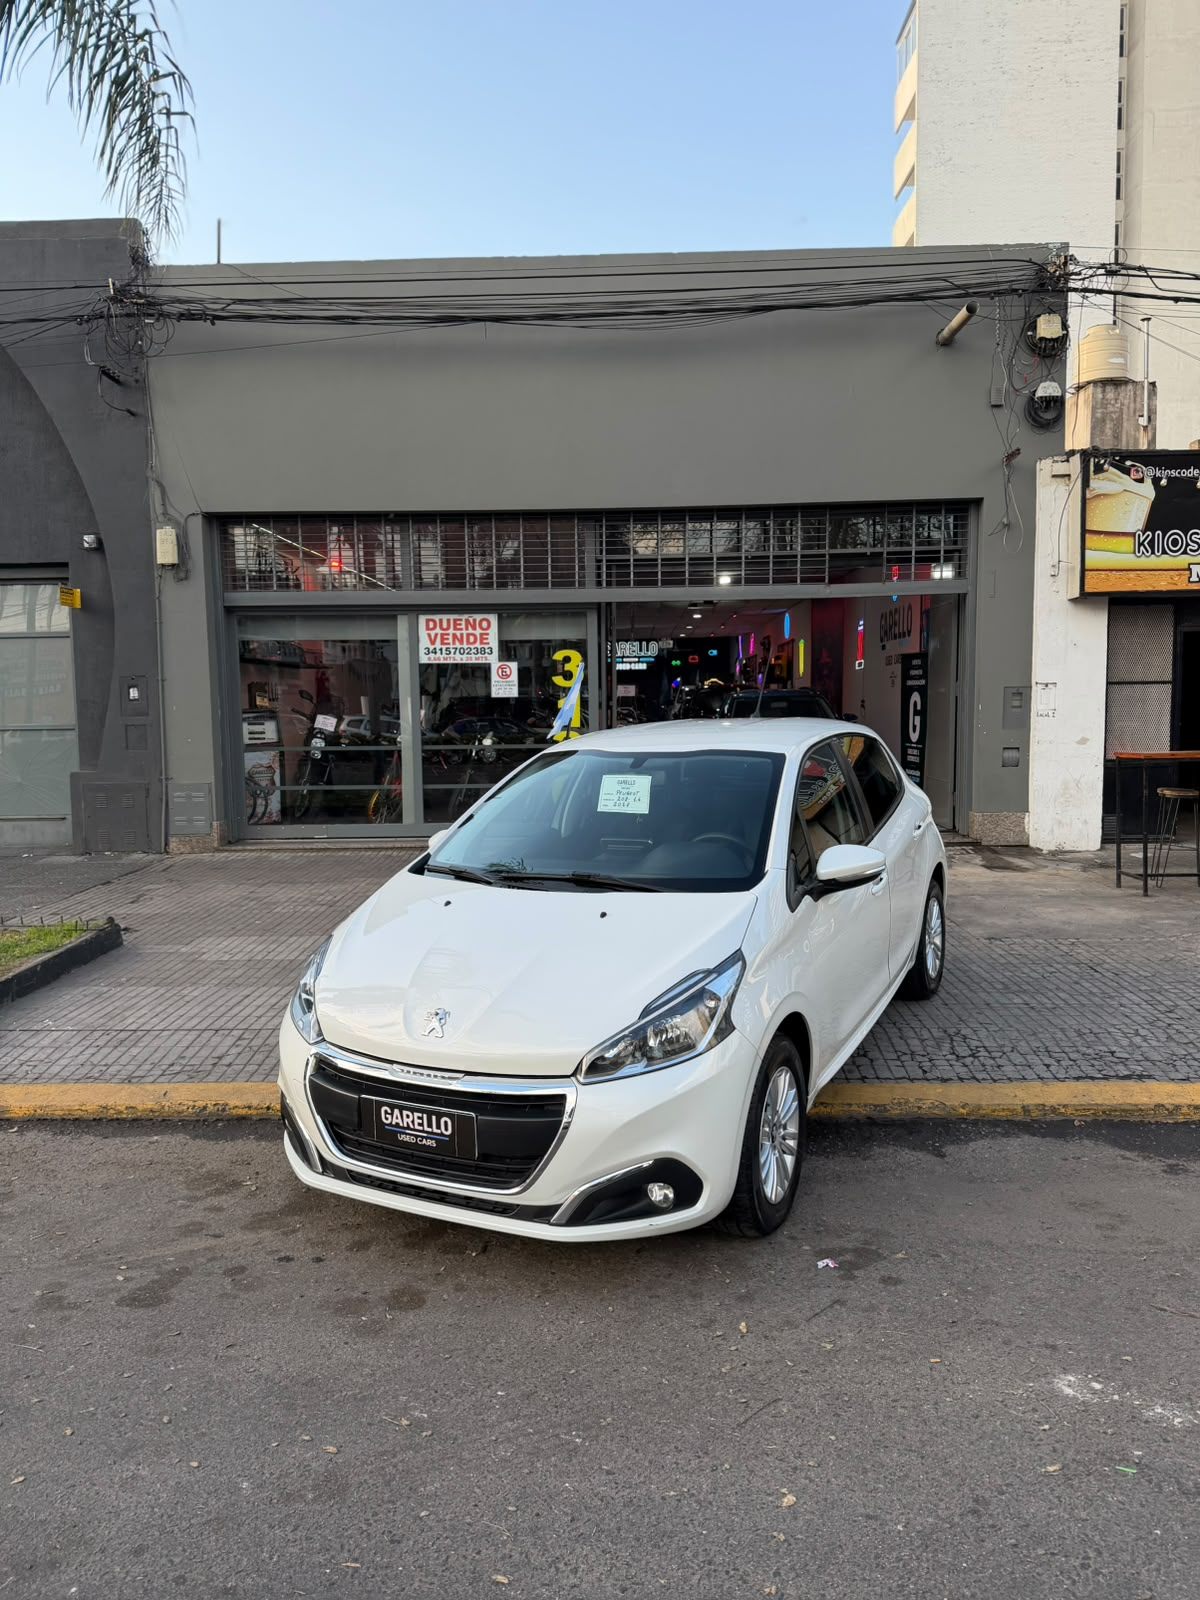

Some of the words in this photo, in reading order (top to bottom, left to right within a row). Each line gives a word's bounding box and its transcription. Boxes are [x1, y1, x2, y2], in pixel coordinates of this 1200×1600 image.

[1135, 529, 1200, 557] KIOS
[425, 615, 492, 632] DUEÑO
[427, 633, 490, 646] VENDE
[424, 647, 493, 655] 3415702383
[908, 691, 922, 743] G
[380, 1105, 452, 1136] GARELLO
[397, 1133, 417, 1144] USED
[417, 1136, 437, 1148] CARS
